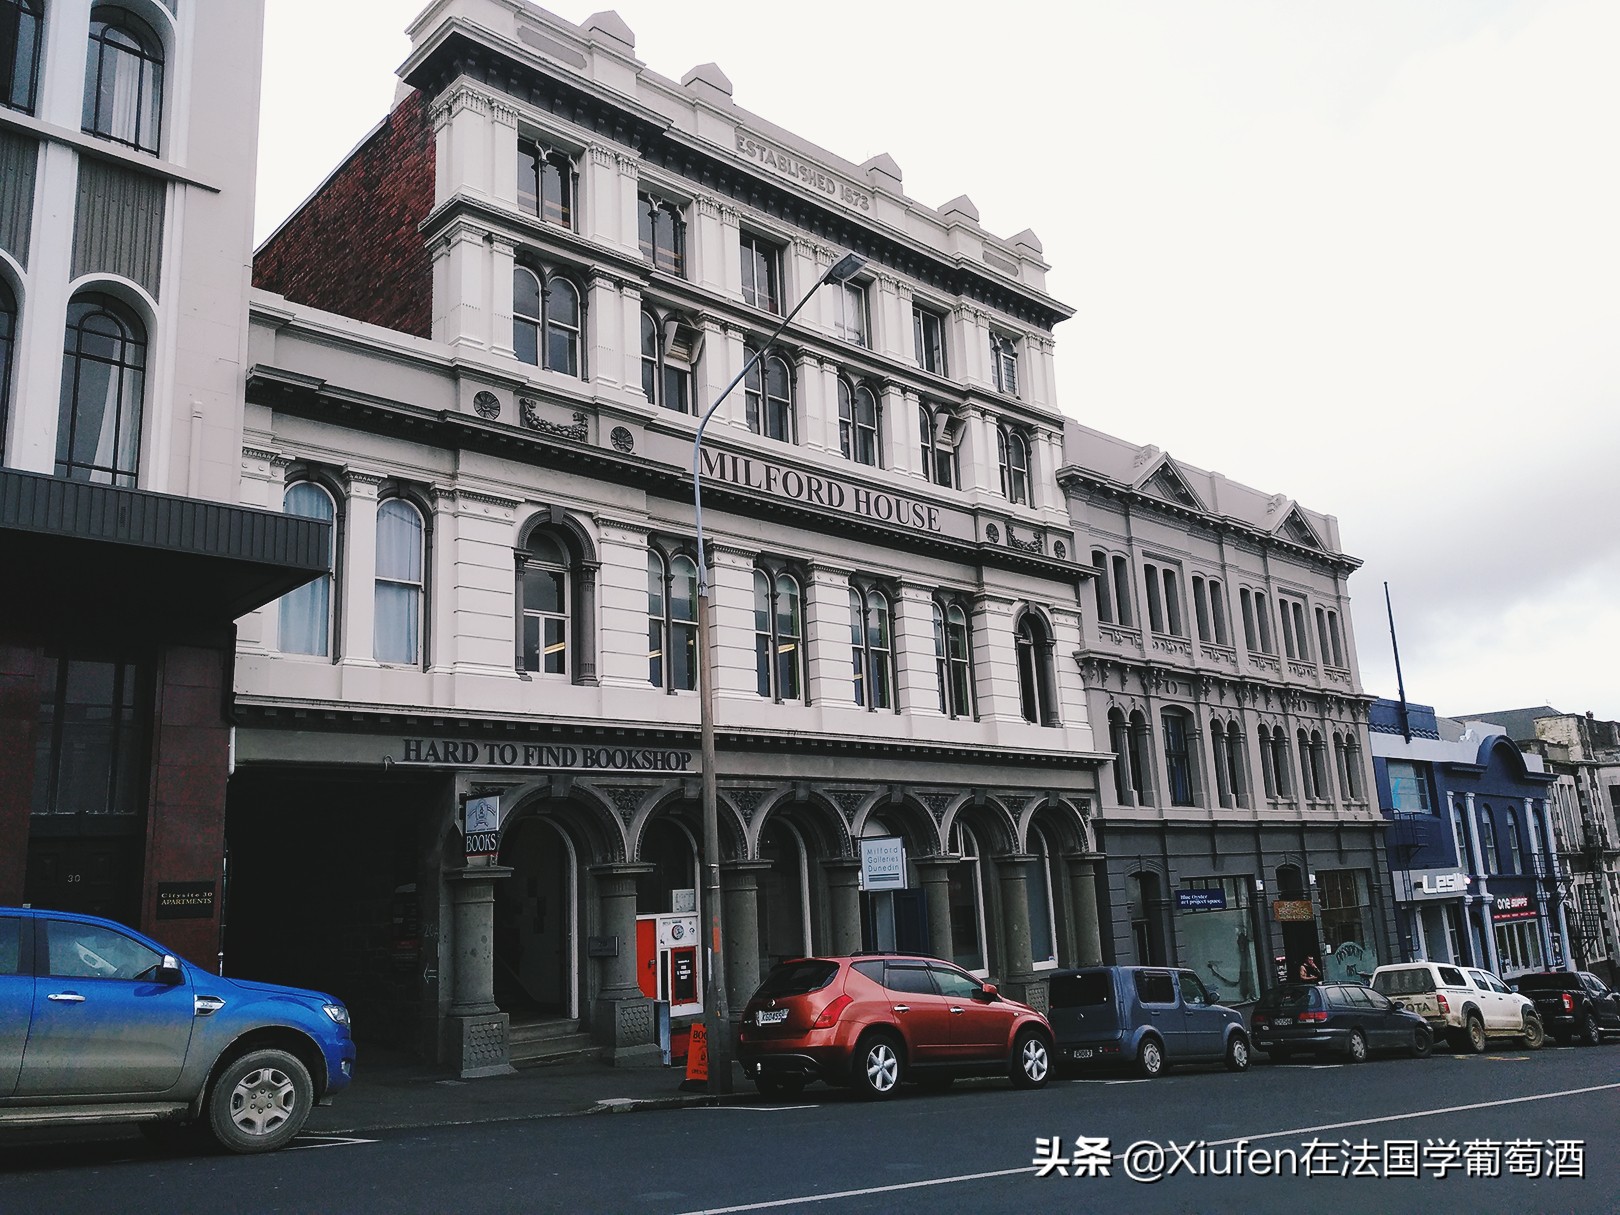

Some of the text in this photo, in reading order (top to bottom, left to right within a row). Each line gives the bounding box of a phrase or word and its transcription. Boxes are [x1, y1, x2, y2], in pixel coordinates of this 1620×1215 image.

[735, 133, 836, 195] ESTABLISHED
[699, 448, 941, 532] MILFORD HOUSE
[402, 739, 692, 771] HARD TO FIND BOOKSHOP
[466, 833, 497, 852] BOOKS
[867, 846, 898, 855] Milford
[867, 856, 899, 864] Galleries
[867, 864, 899, 872] Dunedin
[67, 874, 81, 883] 30
[161, 898, 212, 906] APARTMENTS
[1405, 1002, 1431, 1011] OTA
